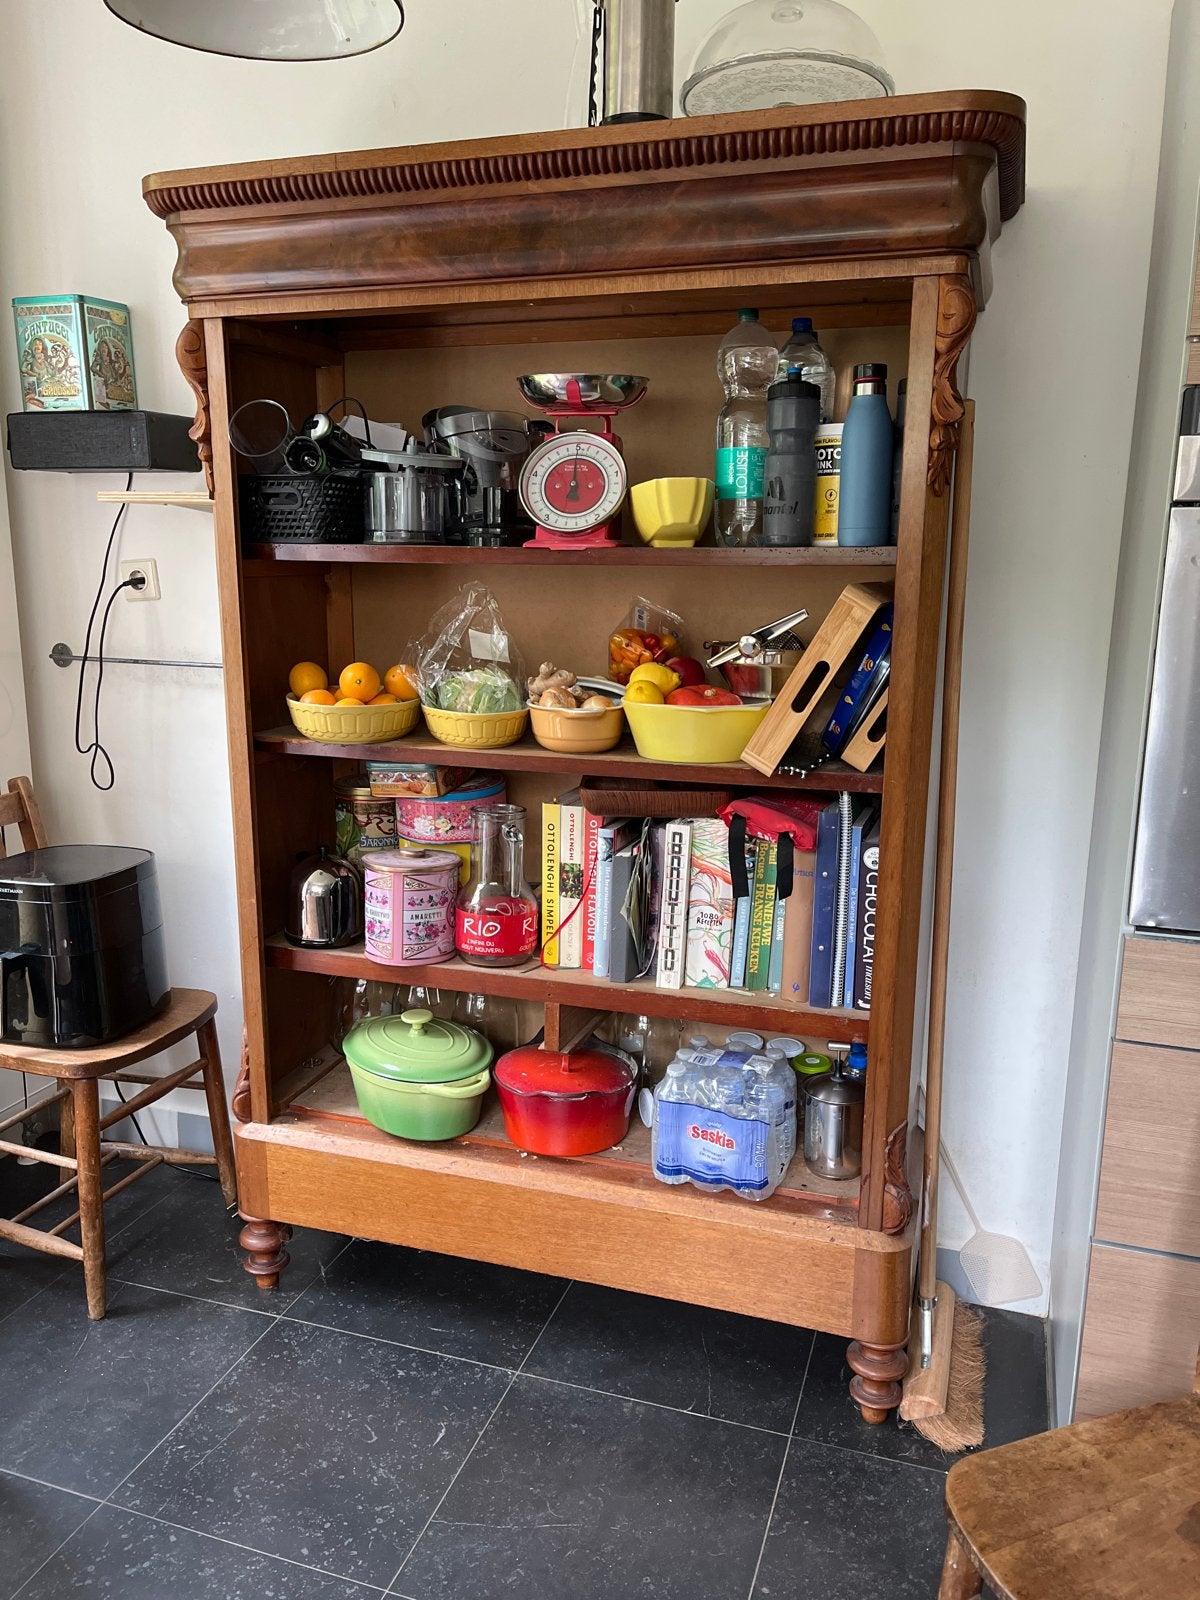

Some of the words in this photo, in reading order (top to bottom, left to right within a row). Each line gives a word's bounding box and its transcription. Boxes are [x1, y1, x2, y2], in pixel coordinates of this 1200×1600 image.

[25, 320, 69, 341] CANTUCCI
[736, 450, 748, 494] LOUISE
[543, 513, 550, 522] 3
[594, 513, 600, 521] 2
[546, 823, 555, 893] OTTOLENGHI
[588, 819, 598, 890] OTTOLENGHI
[757, 843, 768, 879] Bocuse
[753, 883, 765, 926] FRANSE
[766, 883, 776, 899] DE
[410, 911, 442, 921] AMARETTI
[463, 917, 501, 937] RIO
[522, 916, 538, 936] RI
[545, 898, 554, 936] SIMPEL
[587, 894, 597, 942] FLAVOUR
[700, 911, 719, 920] 1080
[761, 900, 775, 946] NIEUWE
[749, 927, 762, 973] KEUKEN
[691, 1125, 735, 1150] Saskia
